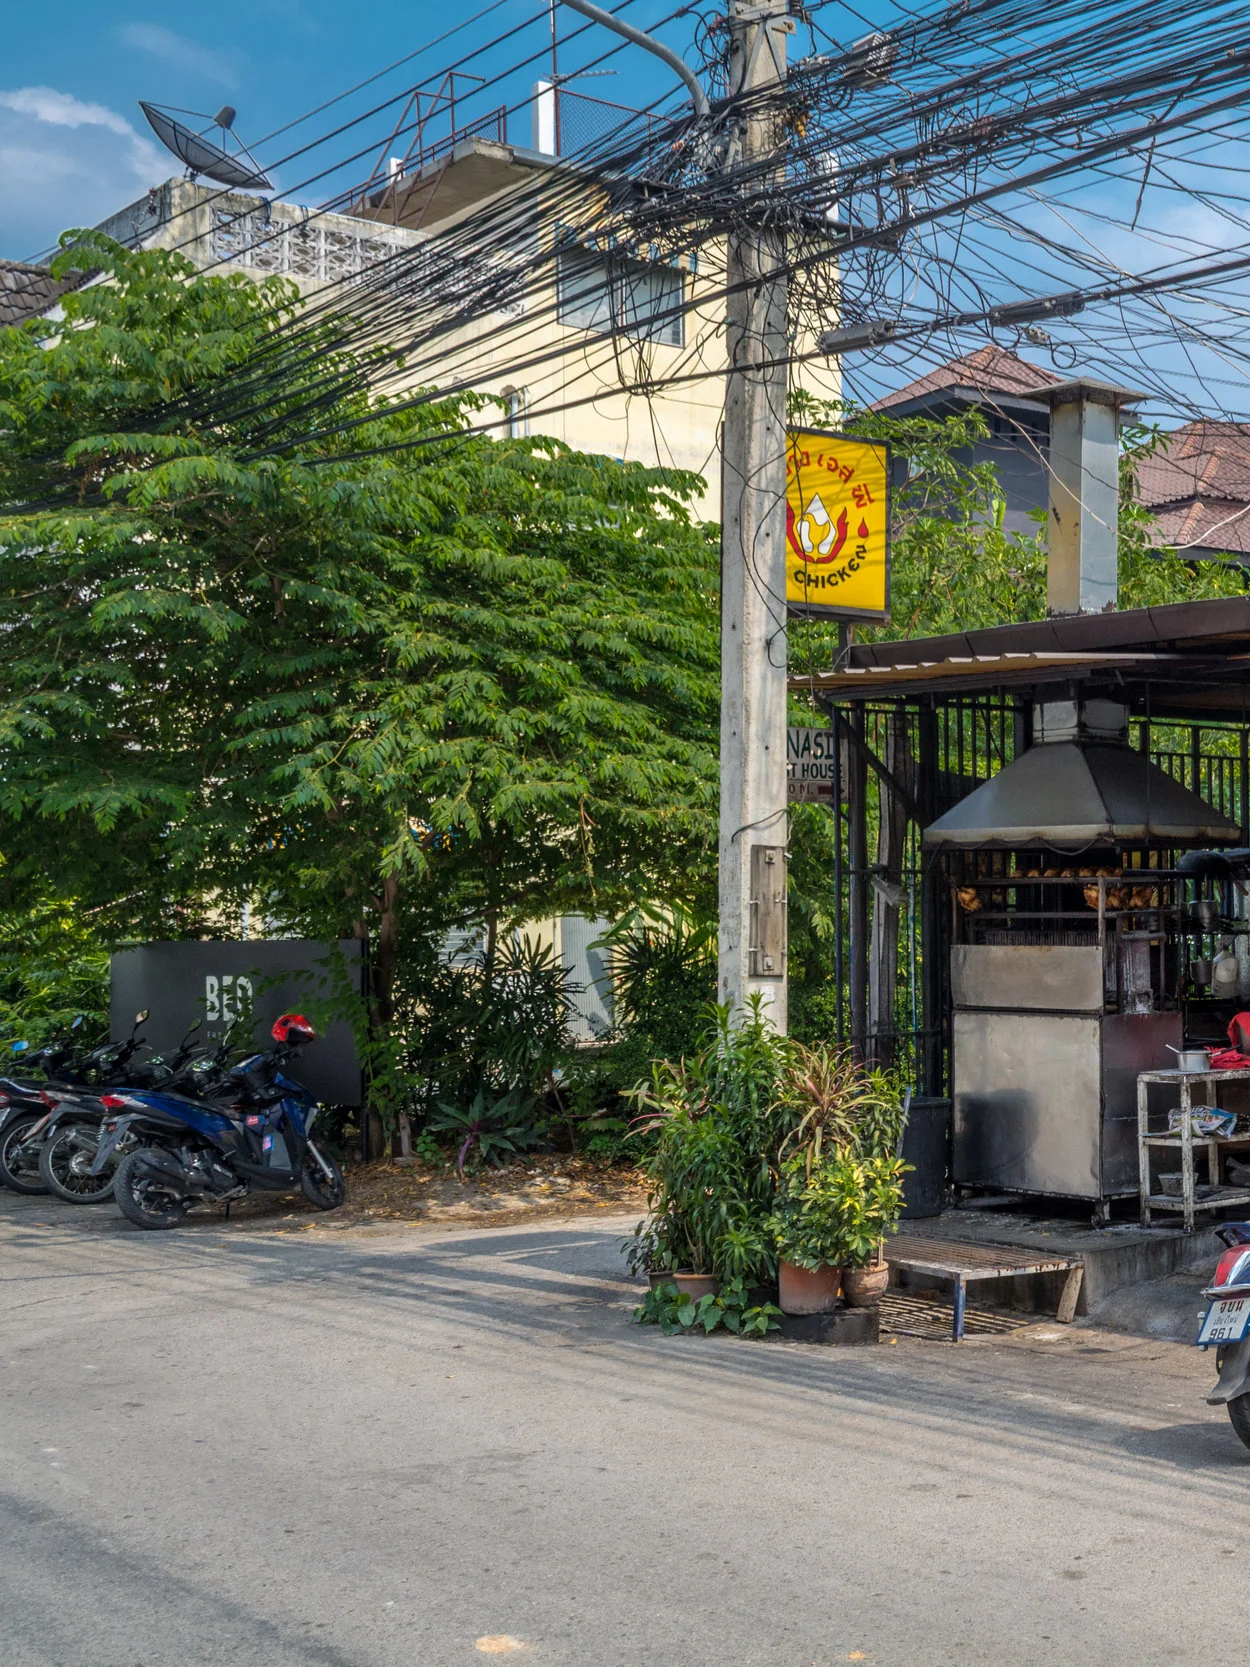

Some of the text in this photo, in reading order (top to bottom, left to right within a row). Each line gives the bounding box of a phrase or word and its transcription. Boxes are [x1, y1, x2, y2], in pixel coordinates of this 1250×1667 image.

[817, 453, 855, 484] เอส
[793, 544, 867, 589] CHICKEN
[801, 762, 843, 779] HOUS
[1209, 1326, 1233, 1340] 961
